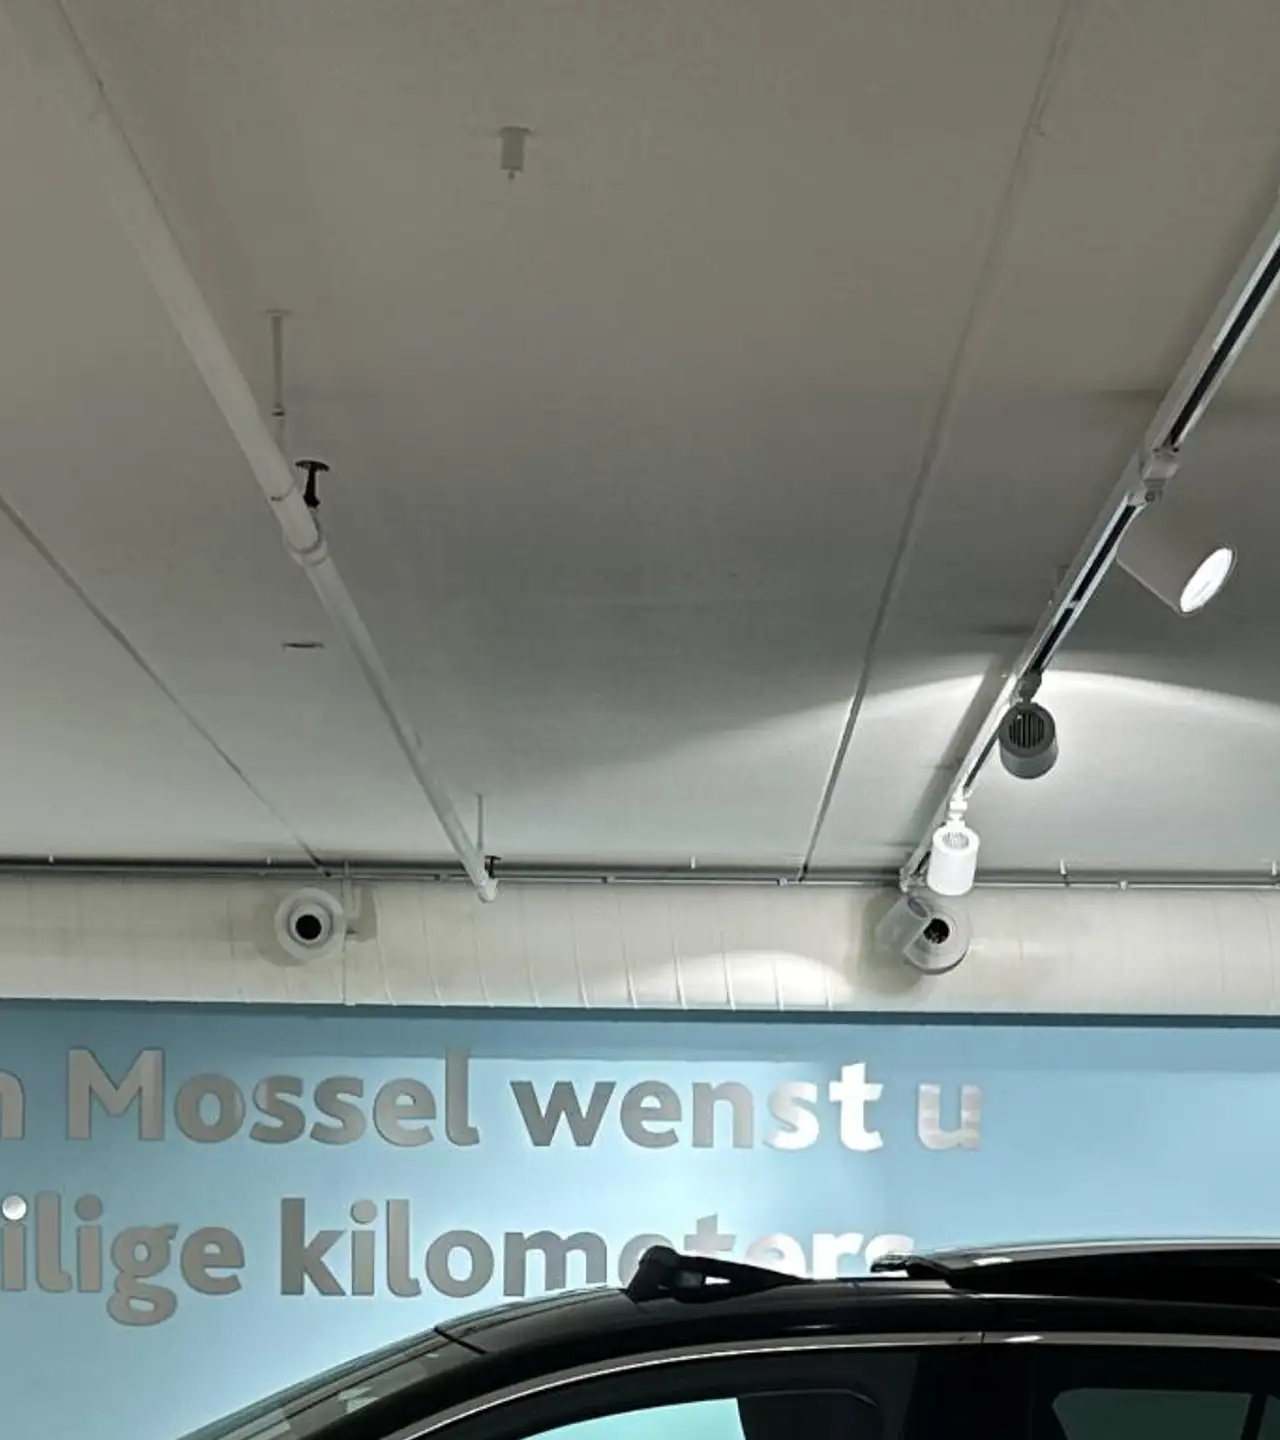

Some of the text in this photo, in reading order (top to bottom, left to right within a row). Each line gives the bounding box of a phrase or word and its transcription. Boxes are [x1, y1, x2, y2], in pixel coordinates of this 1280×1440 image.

[65, 1046, 480, 1148] Mossel
[509, 1061, 884, 1153] wenst
[917, 1083, 984, 1152] u
